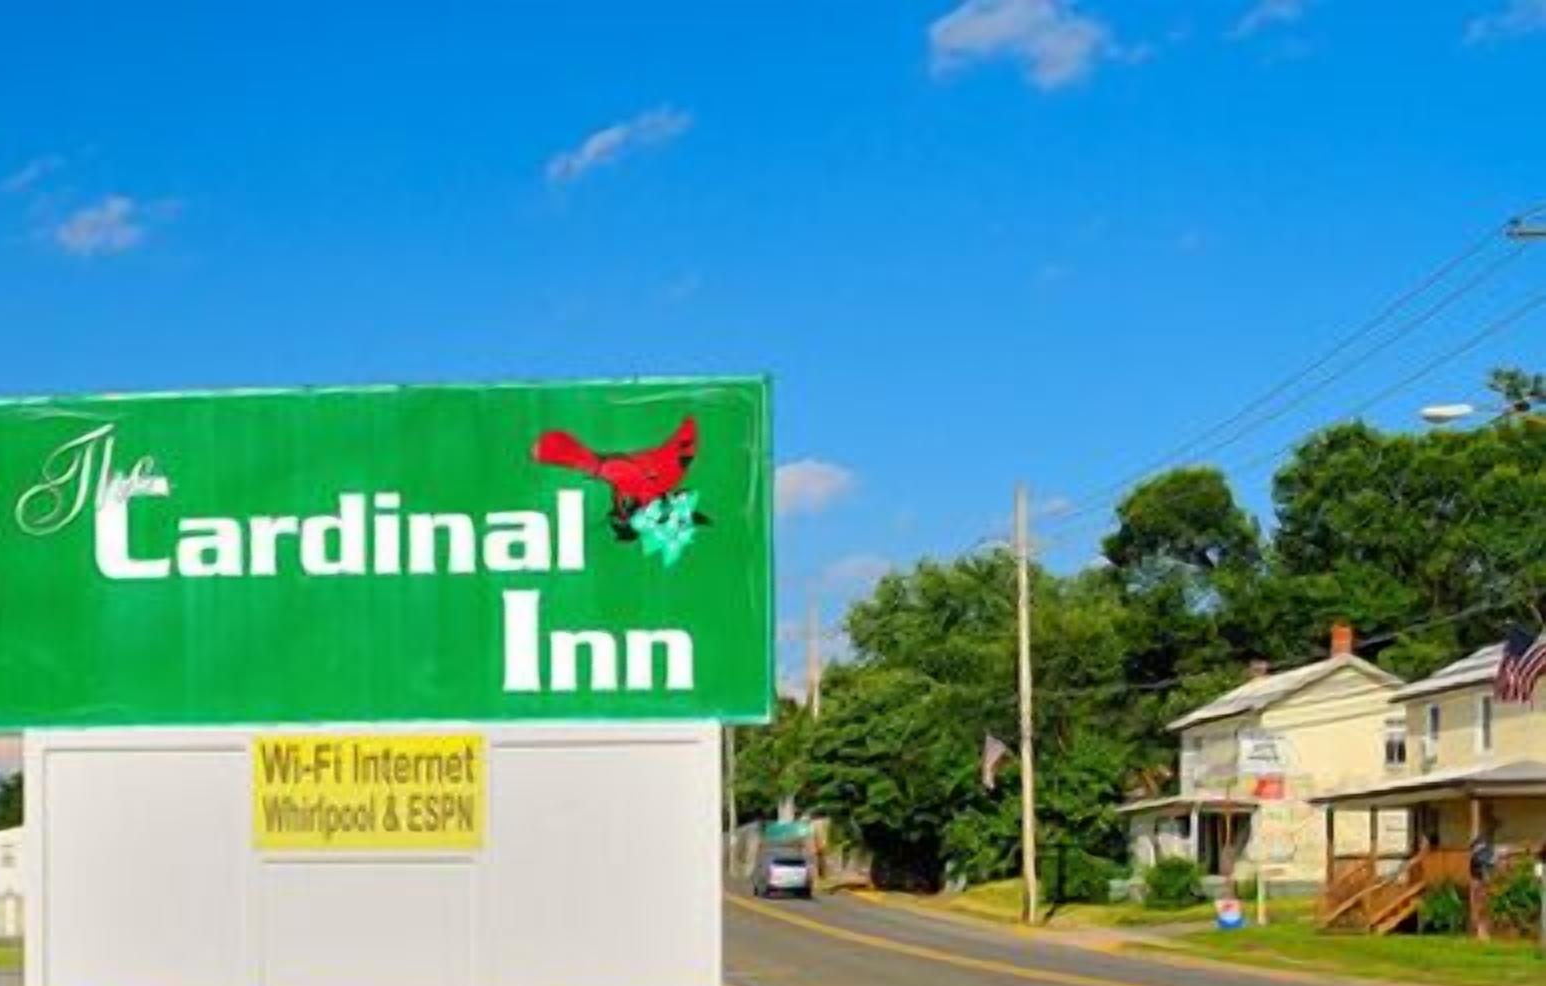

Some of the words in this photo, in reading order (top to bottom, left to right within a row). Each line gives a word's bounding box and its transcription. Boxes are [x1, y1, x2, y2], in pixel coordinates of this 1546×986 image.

[15, 423, 156, 536] The
[95, 477, 585, 579] Cardinal
[502, 589, 695, 692] Inn
[261, 742, 342, 784] Wi-Fi
[353, 742, 475, 784] Internet
[262, 793, 375, 841] Whirlpool
[381, 792, 401, 832] &
[406, 793, 475, 832] ESPN
